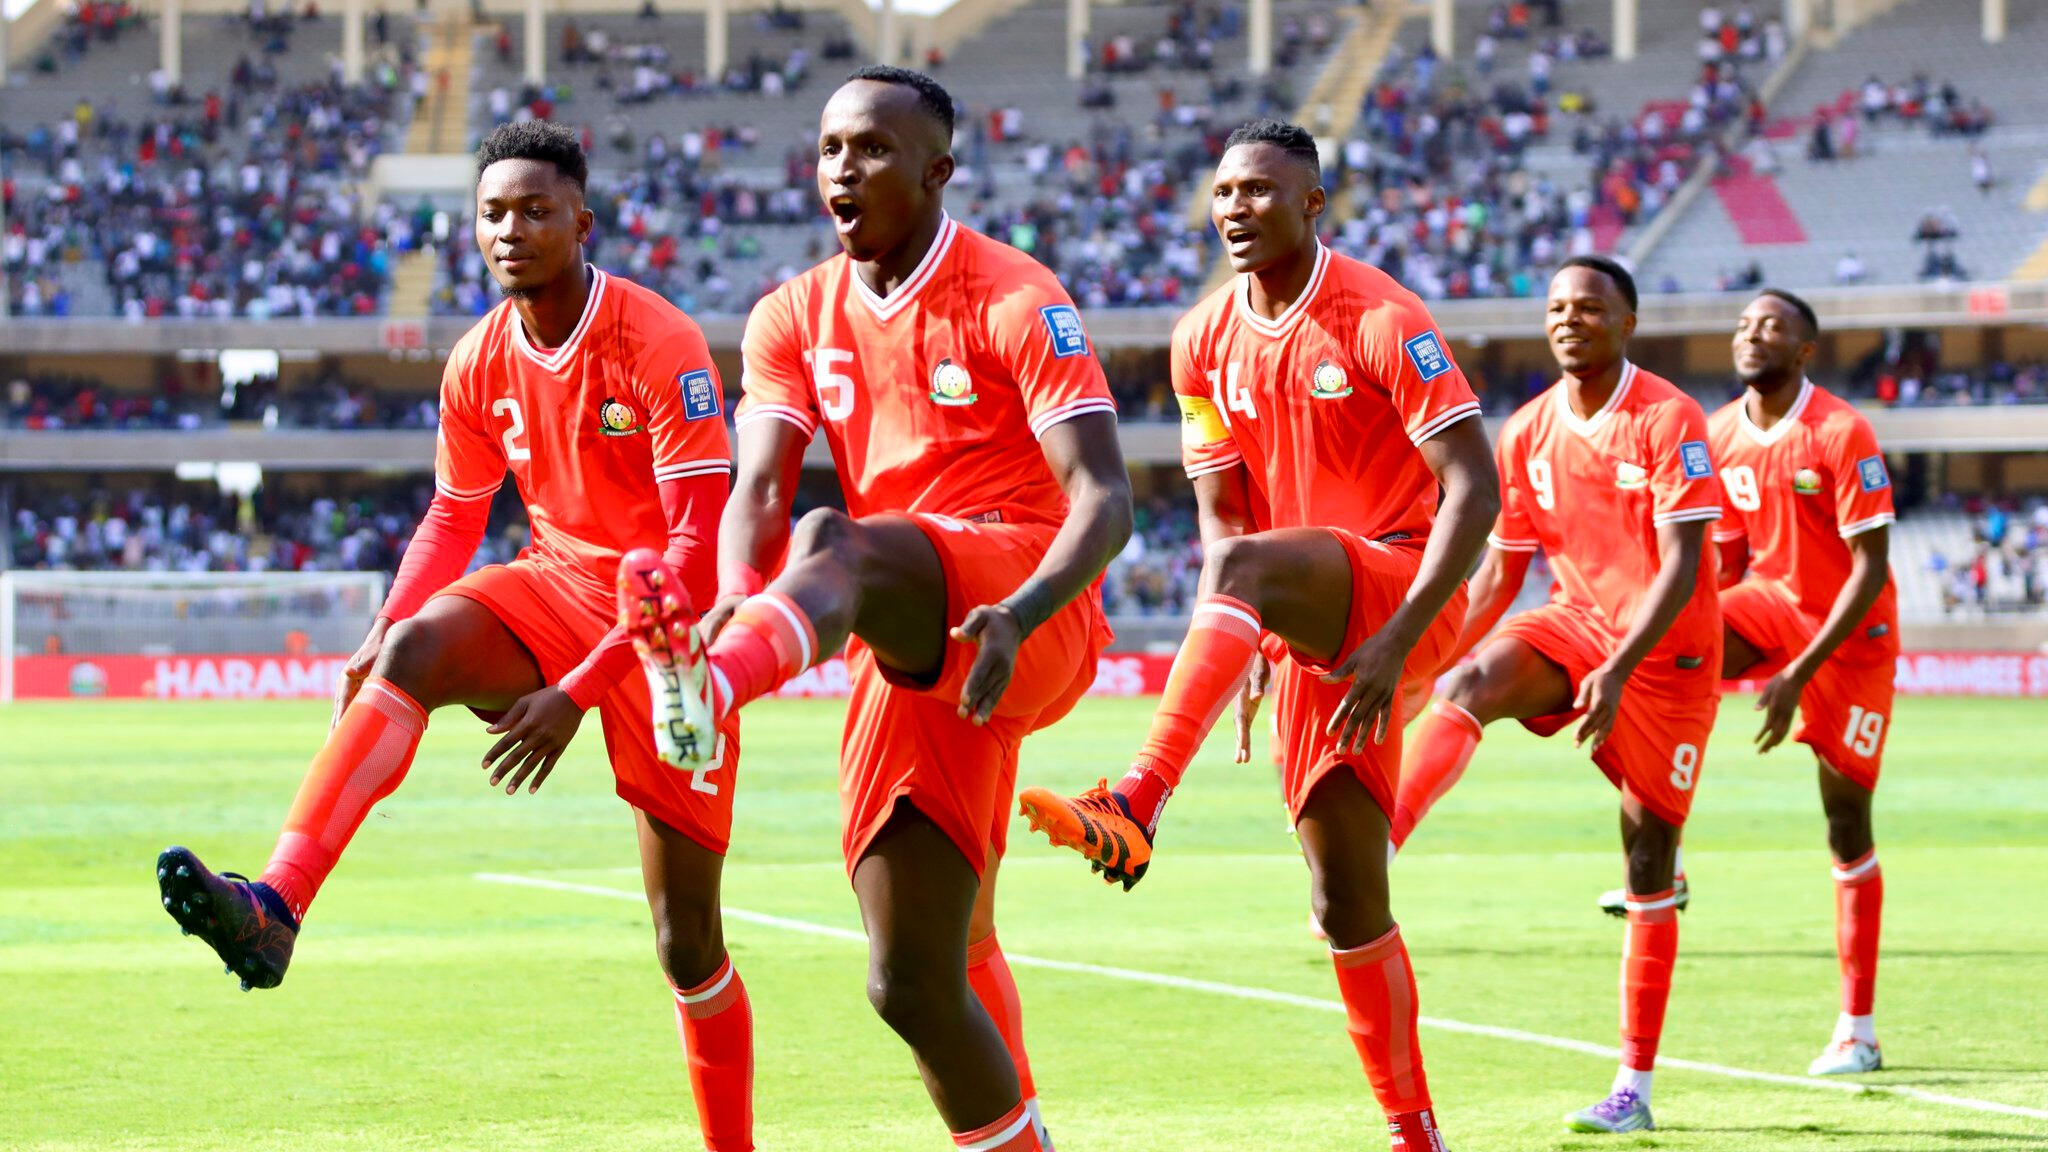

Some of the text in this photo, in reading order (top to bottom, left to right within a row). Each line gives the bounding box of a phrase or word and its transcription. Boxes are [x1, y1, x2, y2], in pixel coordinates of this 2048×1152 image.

[1417, 344, 1438, 358] UNITES
[688, 376, 708, 387] FOOTBALL
[689, 384, 710, 395] UNITES
[1206, 361, 1258, 428] 14
[492, 397, 531, 460] 2
[1527, 459, 1555, 510] 9
[1720, 465, 1761, 511] 19
[1843, 705, 1884, 758] 19
[1670, 742, 1698, 790] 9
